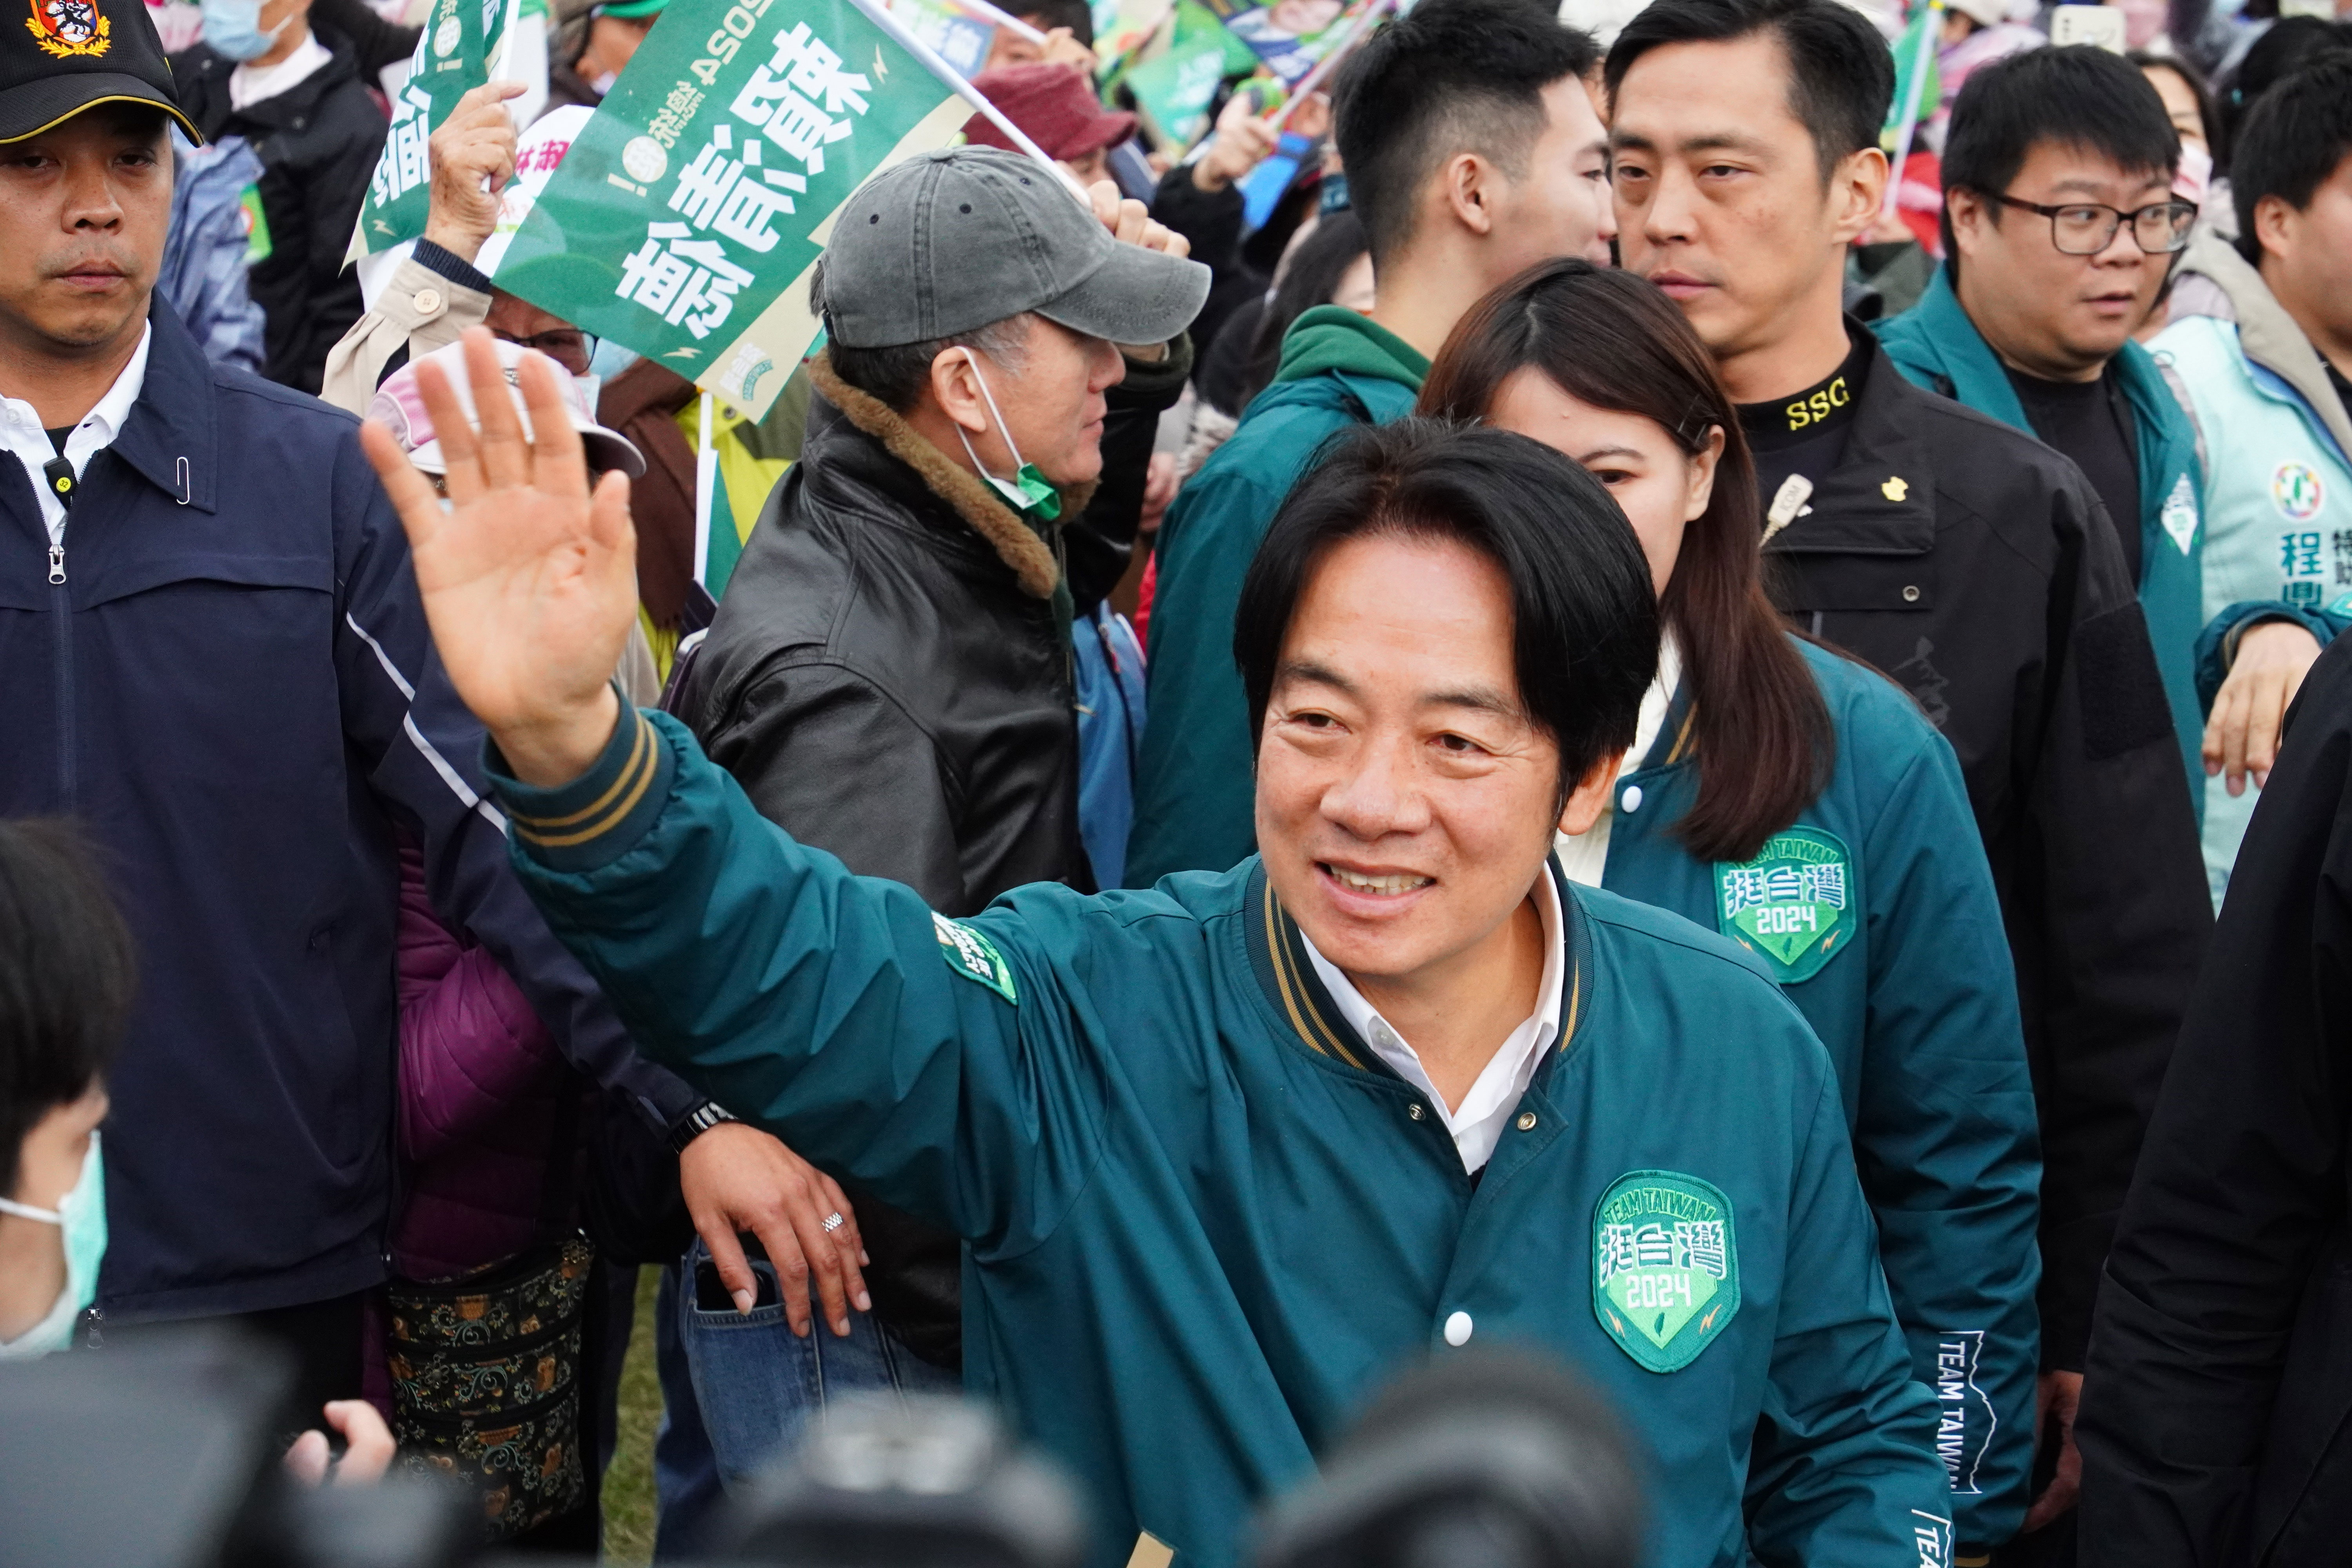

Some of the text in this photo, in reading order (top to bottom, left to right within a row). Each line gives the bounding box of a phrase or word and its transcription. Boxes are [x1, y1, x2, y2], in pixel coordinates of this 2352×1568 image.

[60, 480, 68, 488] 32
[1774, 838, 1838, 863] TAIWAN
[1724, 862, 1845, 919] 挺台灣
[1757, 906, 1817, 934] 2024
[1604, 1187, 1716, 1224] TEAM TAIWAN
[1600, 1220, 1727, 1288] 挺台灣
[1626, 1274, 1691, 1308] 2024
[1938, 1341, 1965, 1399] TEAM
